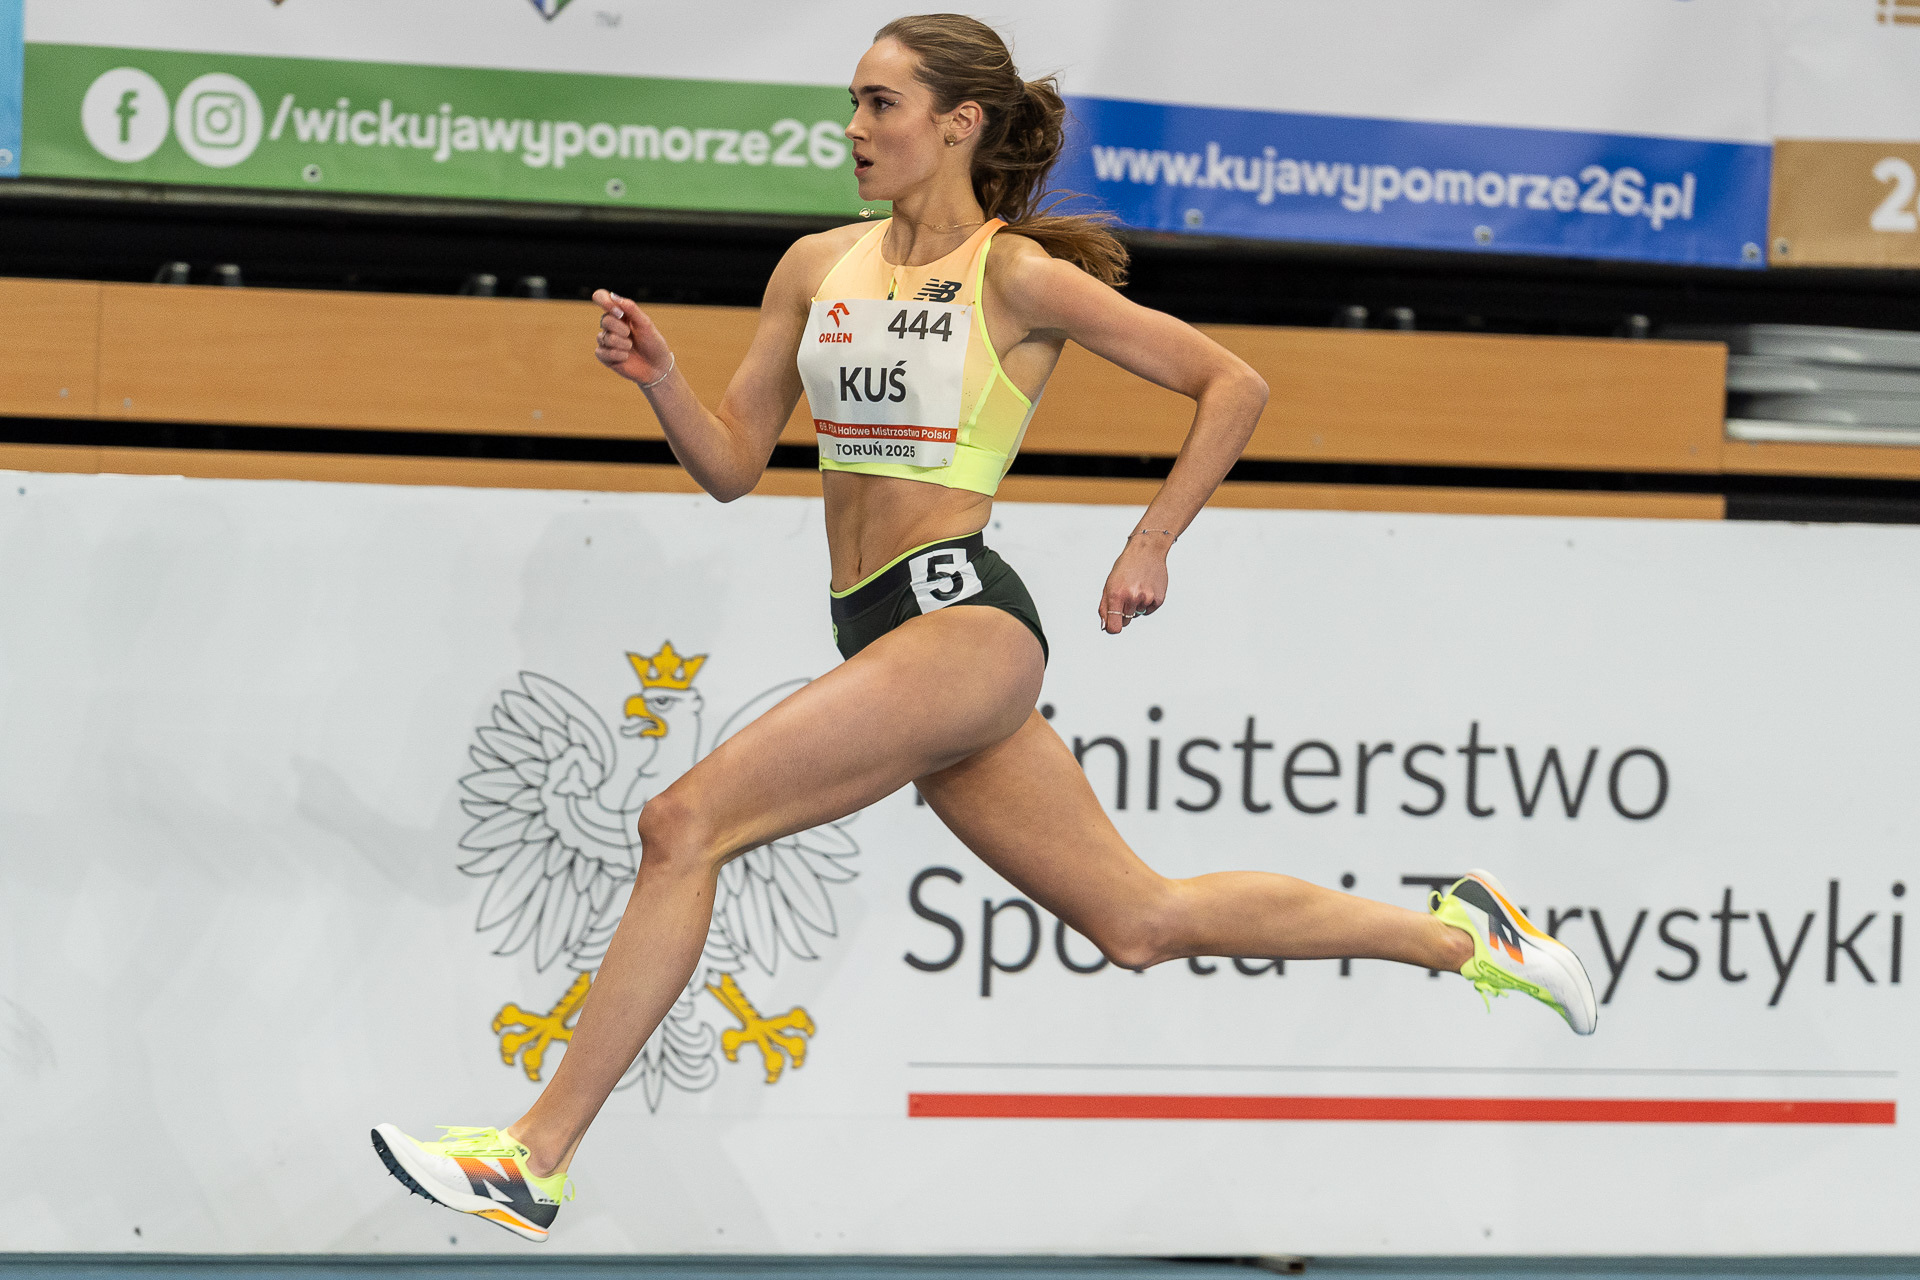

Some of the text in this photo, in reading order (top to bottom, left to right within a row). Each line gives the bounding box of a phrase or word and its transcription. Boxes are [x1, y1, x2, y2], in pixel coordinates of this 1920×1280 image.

[269, 94, 847, 169] /wickujawypomorze26
[1092, 142, 1696, 230] www.kujawypomorze26.pl
[1870, 156, 1920, 232] 2
[818, 332, 852, 344] ORLEN
[887, 309, 952, 342] 444
[839, 360, 907, 403] KUŚ
[836, 441, 915, 458] TORUŃ 2025
[838, 426, 870, 435] Halowe
[871, 426, 919, 438] Mistrzostwa
[921, 429, 951, 440] Polski
[926, 553, 964, 602] 5
[915, 704, 1670, 822] nisterstwo
[1401, 874, 1906, 1007] Trystyki
